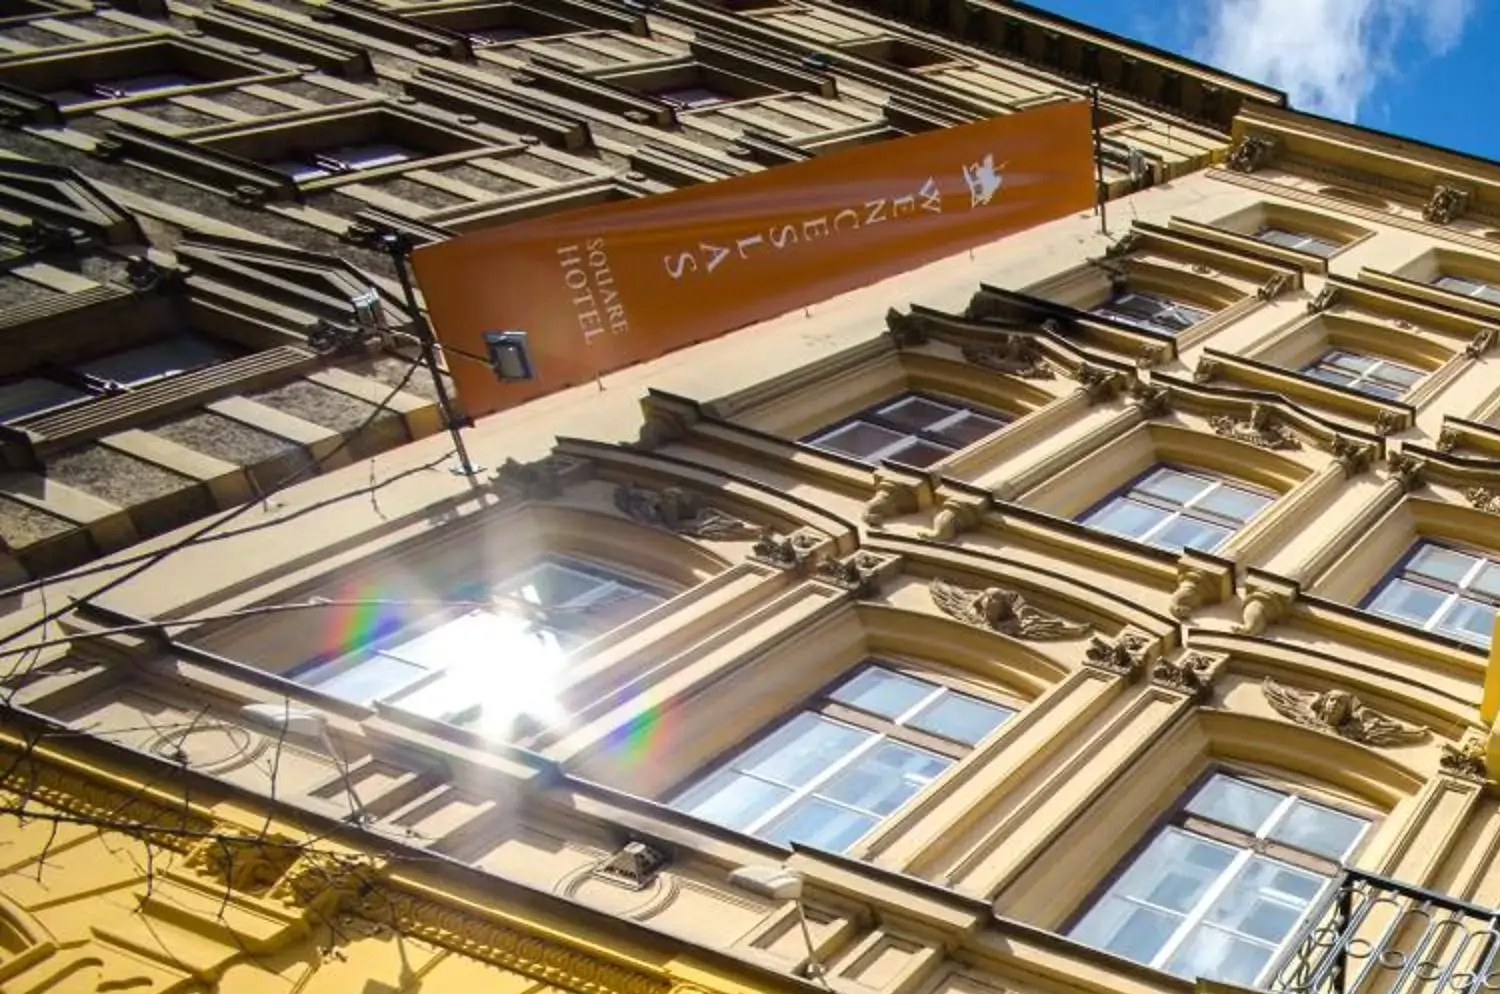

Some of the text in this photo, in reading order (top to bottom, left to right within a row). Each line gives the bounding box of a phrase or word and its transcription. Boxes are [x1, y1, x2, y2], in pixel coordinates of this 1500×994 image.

[664, 176, 942, 279] WENCESLAS
[557, 244, 605, 346] HOTEL
[587, 237, 630, 335] SQUARE
